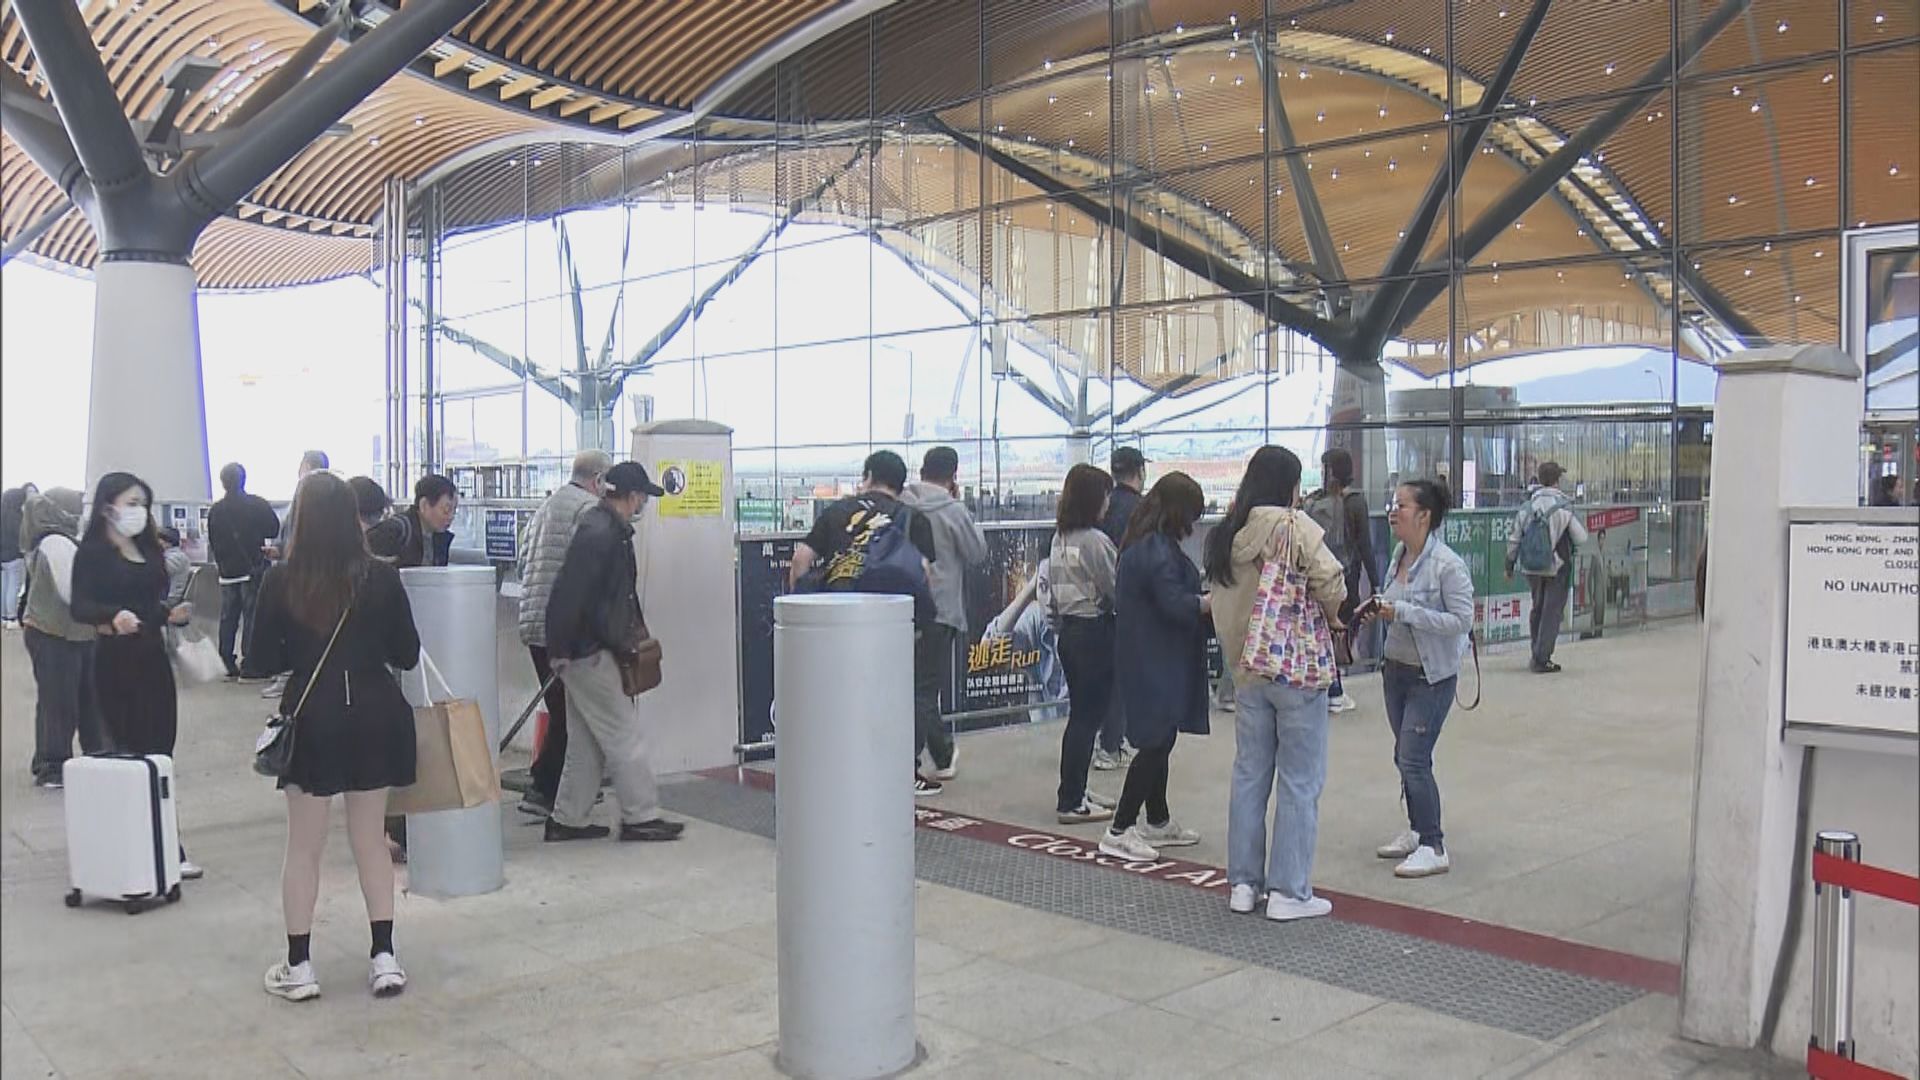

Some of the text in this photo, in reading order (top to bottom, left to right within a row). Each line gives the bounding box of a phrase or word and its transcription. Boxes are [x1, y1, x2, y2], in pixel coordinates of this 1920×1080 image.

[1825, 534, 1852, 543] HONG
[1856, 535, 1881, 543] KONG
[1807, 546, 1914, 556] HONG KONG PORT AND
[1824, 580, 1845, 591] NO
[967, 635, 1041, 673] 逃走 Run
